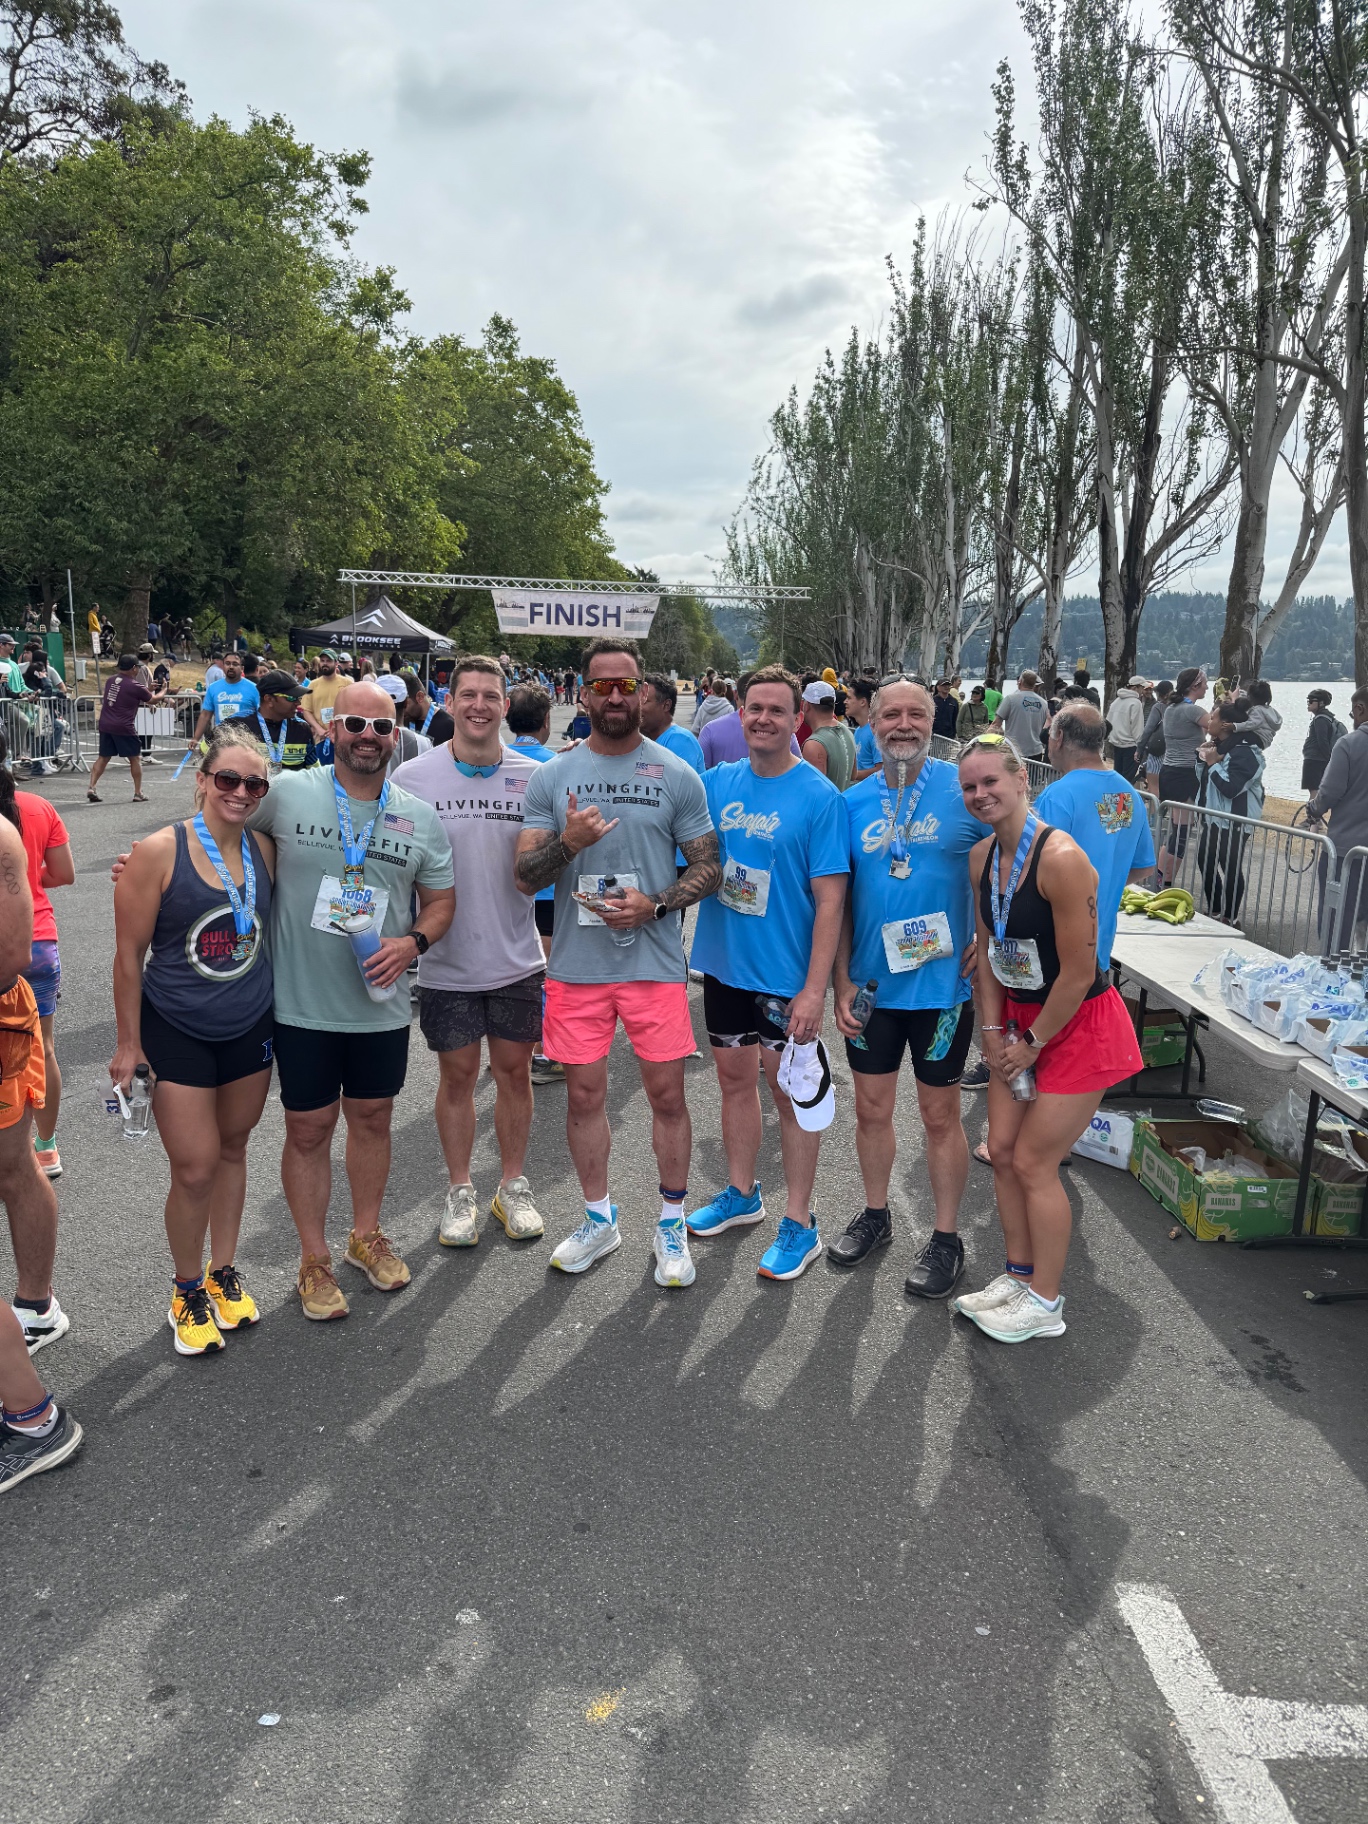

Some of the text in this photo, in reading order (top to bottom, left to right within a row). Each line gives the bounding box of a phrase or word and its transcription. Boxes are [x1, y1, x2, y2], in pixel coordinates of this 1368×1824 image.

[529, 602, 621, 628] FINISH
[436, 800, 521, 811] LIVINGFI
[383, 854, 407, 867] STATES
[735, 866, 747, 881] 99
[903, 920, 927, 936] 609
[201, 931, 229, 944] BULL
[1090, 1117, 1111, 1135] QA
[1210, 1197, 1236, 1206] BANANAS
